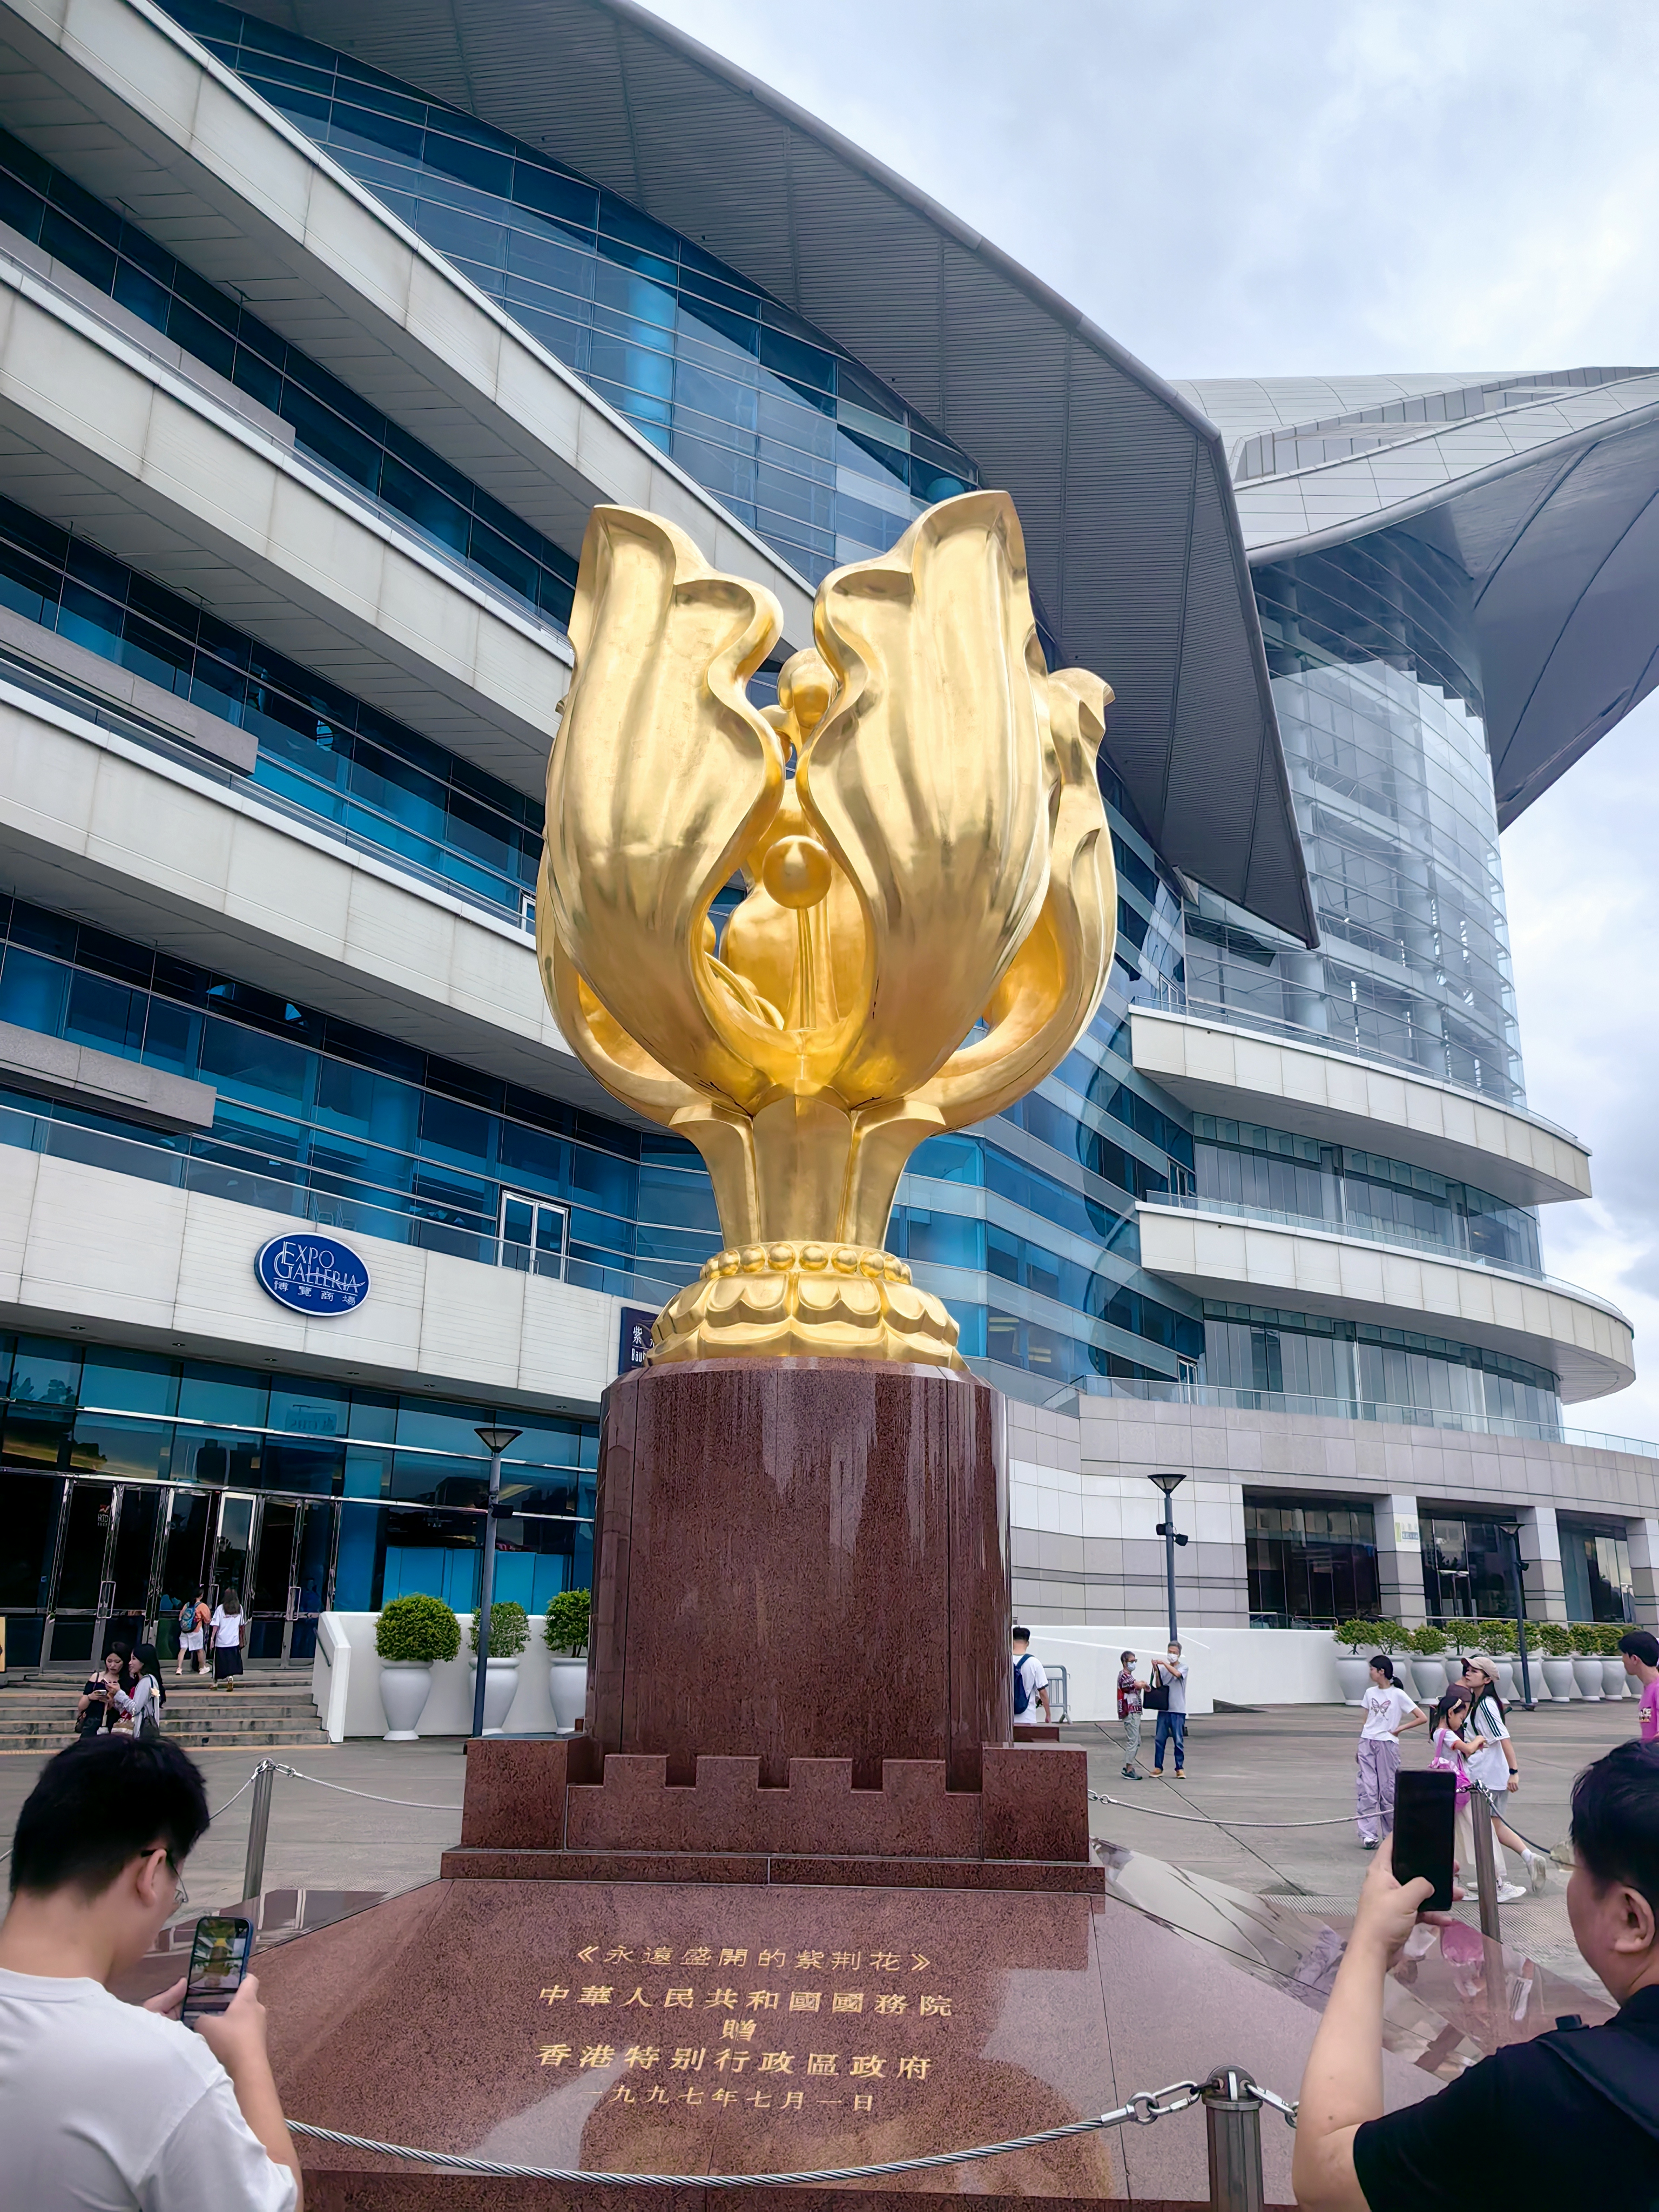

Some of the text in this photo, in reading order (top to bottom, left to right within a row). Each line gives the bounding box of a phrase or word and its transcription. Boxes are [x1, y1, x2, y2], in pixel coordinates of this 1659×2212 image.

[281, 1241, 334, 1269] EXPO
[274, 1251, 358, 1293] GALLERIA
[274, 1280, 356, 1306] 博覽商場
[539, 1985, 953, 2017] 中華人民共和國國務院
[720, 2019, 757, 2041] 贈
[581, 2085, 873, 2112] 一九九七年七月一日
